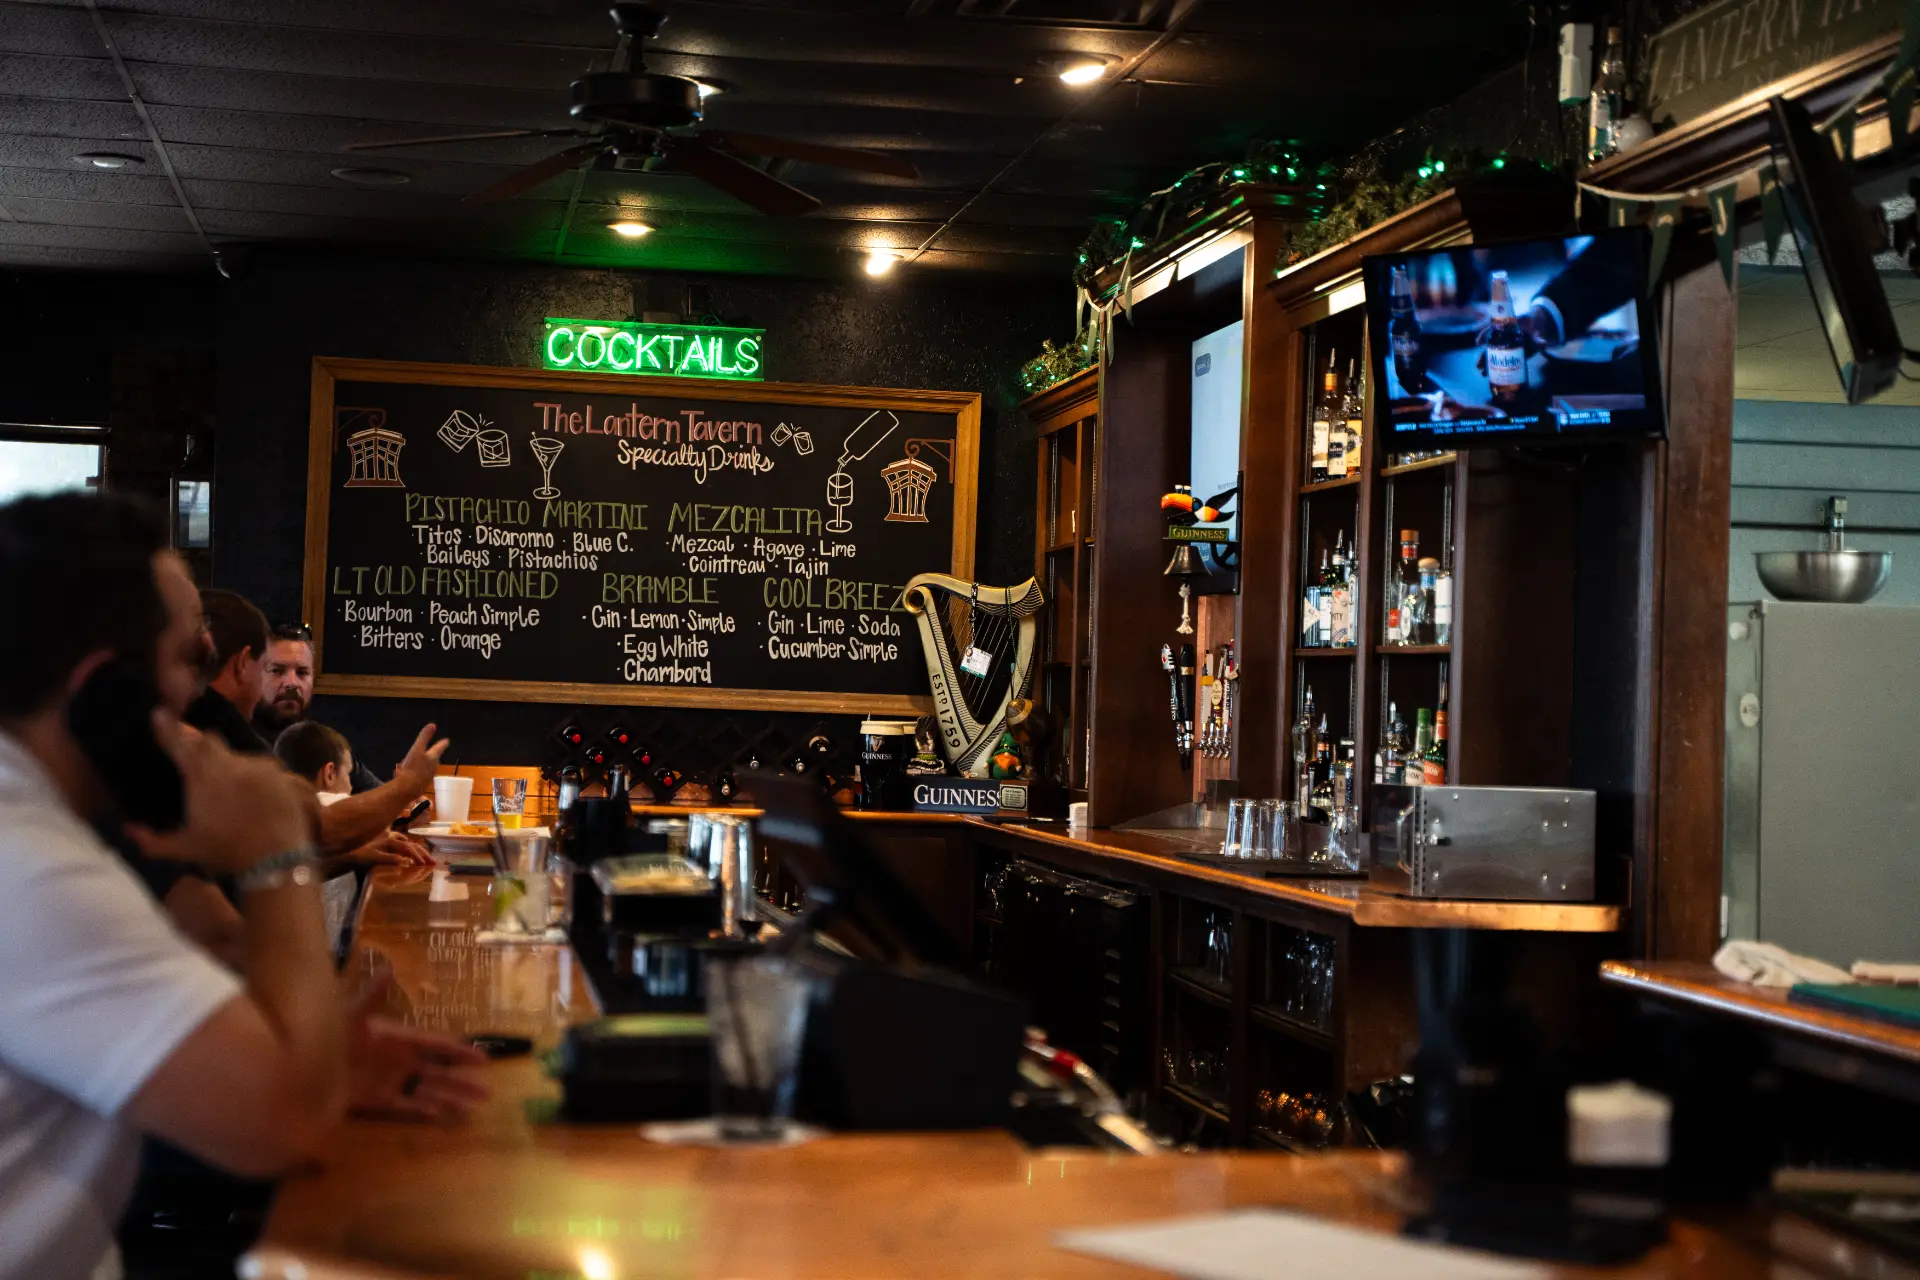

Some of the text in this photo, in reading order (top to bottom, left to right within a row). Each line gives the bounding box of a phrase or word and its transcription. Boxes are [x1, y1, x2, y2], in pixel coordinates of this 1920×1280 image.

[547, 327, 760, 375] COCKTAILS
[533, 402, 762, 444] The Lantern Tavern
[617, 439, 774, 484] Specialty Drinks
[405, 493, 648, 530] PISTACHIO MARTINI
[667, 502, 822, 536] MEZCALITA
[412, 524, 634, 552] Titos Disaronno Blue C.
[671, 534, 856, 562] Mezcal Agave Lime
[1173, 528, 1225, 539] GUINNESS
[427, 545, 599, 571] Baileys Pistachios
[689, 555, 828, 579] Cointreau Tajin
[375, 565, 416, 595] OLD
[422, 567, 559, 599] FASHIONED
[602, 572, 719, 604] BRAMBLE
[763, 576, 822, 610] COOL
[344, 600, 540, 631] Bourbon Peach Simple
[591, 605, 735, 634] Gin Lemon Simple
[768, 610, 900, 637] Gin Lime Soda
[360, 624, 502, 659] Bitters Orange
[623, 633, 709, 662] Egg White
[768, 635, 898, 663] Cucumber Simple
[624, 658, 712, 684] Chambord
[940, 709, 960, 748] 1759
[861, 751, 893, 760] GUINNESS
